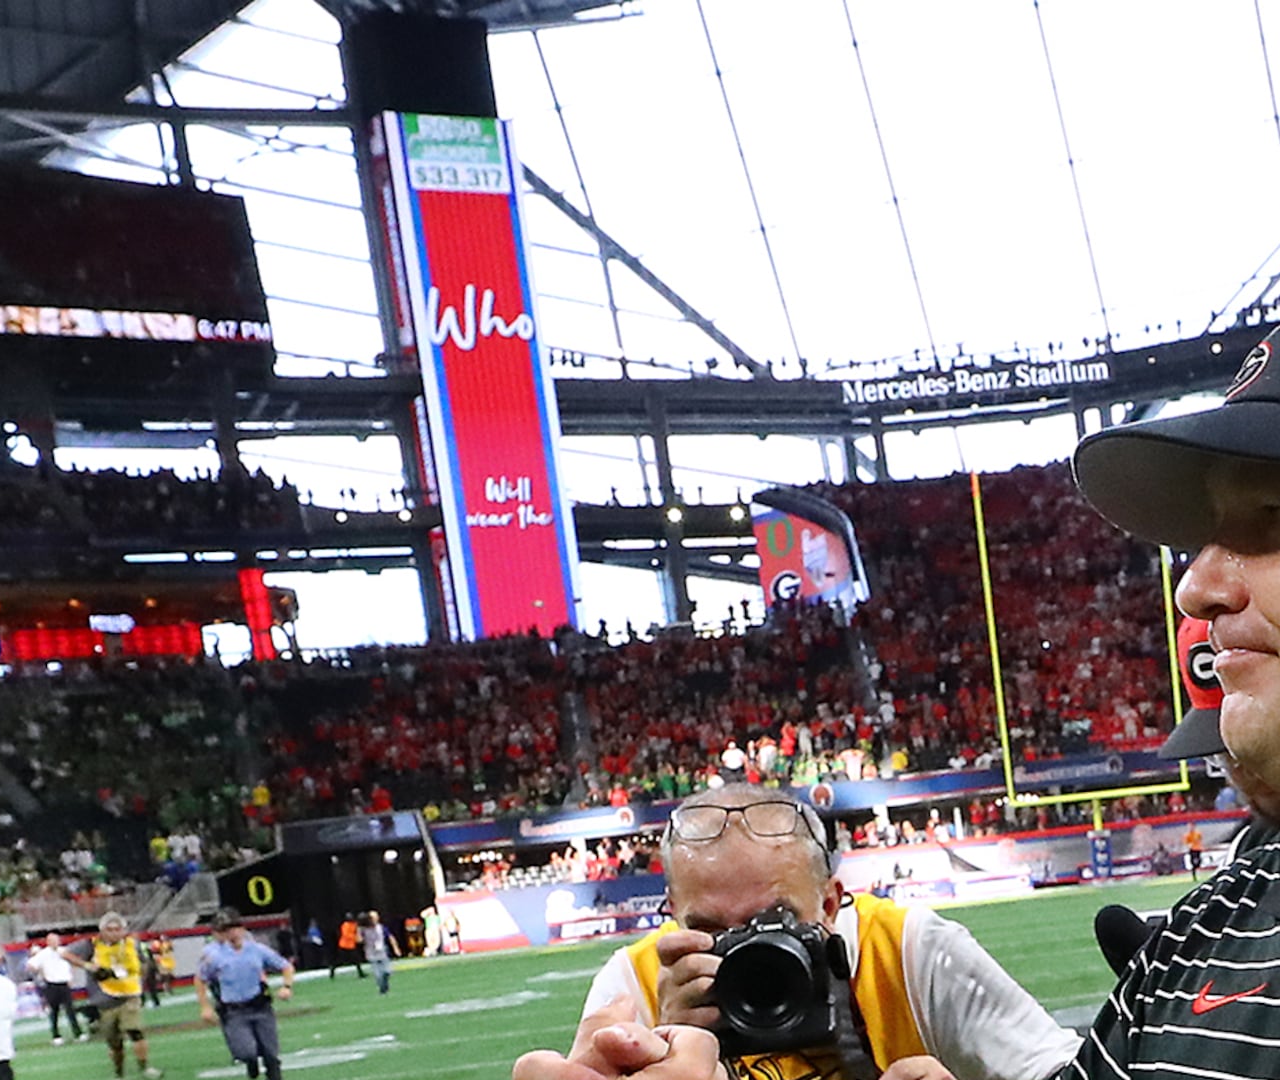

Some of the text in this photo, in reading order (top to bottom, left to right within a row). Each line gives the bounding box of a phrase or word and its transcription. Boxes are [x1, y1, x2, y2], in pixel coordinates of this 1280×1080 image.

[415, 166, 502, 187] $33,317
[197, 318, 271, 341] 6:47 PM
[426, 284, 535, 350] Who
[843, 361, 1109, 404] Mercedes-Benz Stadium
[485, 475, 531, 503] Will
[465, 512, 514, 527] wear
